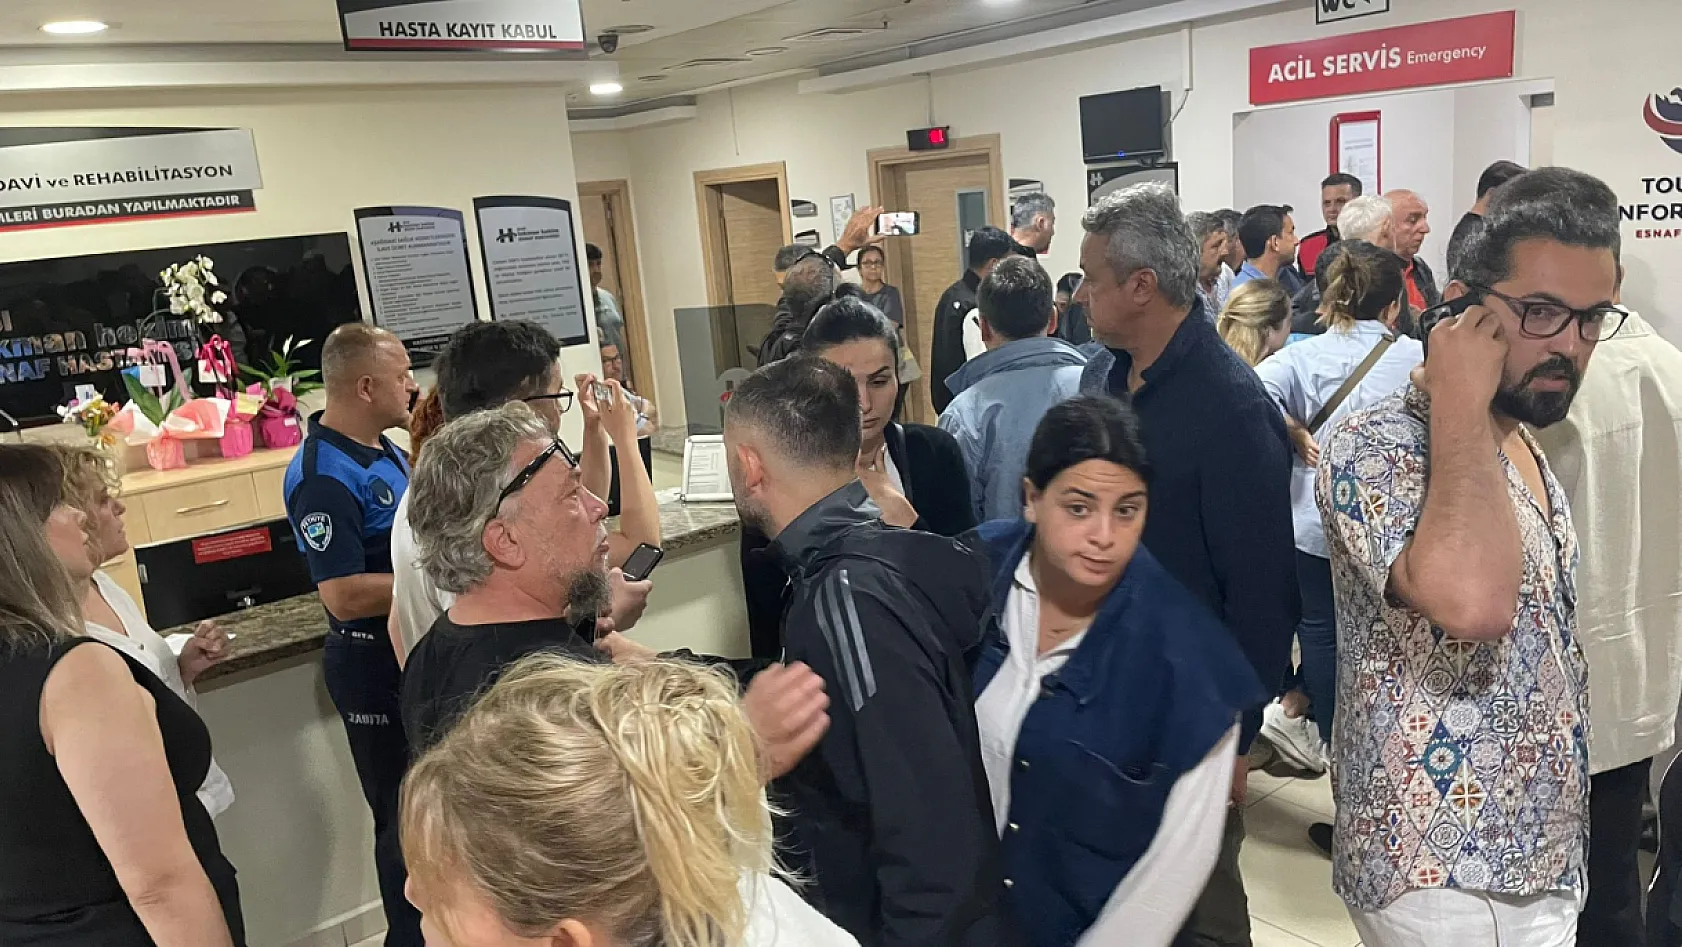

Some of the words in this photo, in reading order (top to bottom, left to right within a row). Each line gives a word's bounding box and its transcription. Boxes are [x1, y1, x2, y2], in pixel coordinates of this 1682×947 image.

[379, 21, 441, 37] HASTA
[446, 22, 496, 38] KAYIT
[501, 23, 557, 39] KABUL
[1268, 54, 1316, 83] ACİL
[1322, 42, 1401, 77] SERVİS
[1406, 45, 1487, 65] Emergency
[47, 177, 68, 188] ve
[73, 164, 232, 186] REHABİLİTASYON
[42, 203, 120, 219] BURADAN
[123, 195, 240, 213] YAPILMAKTADIR
[1635, 229, 1682, 239] ESNAF
